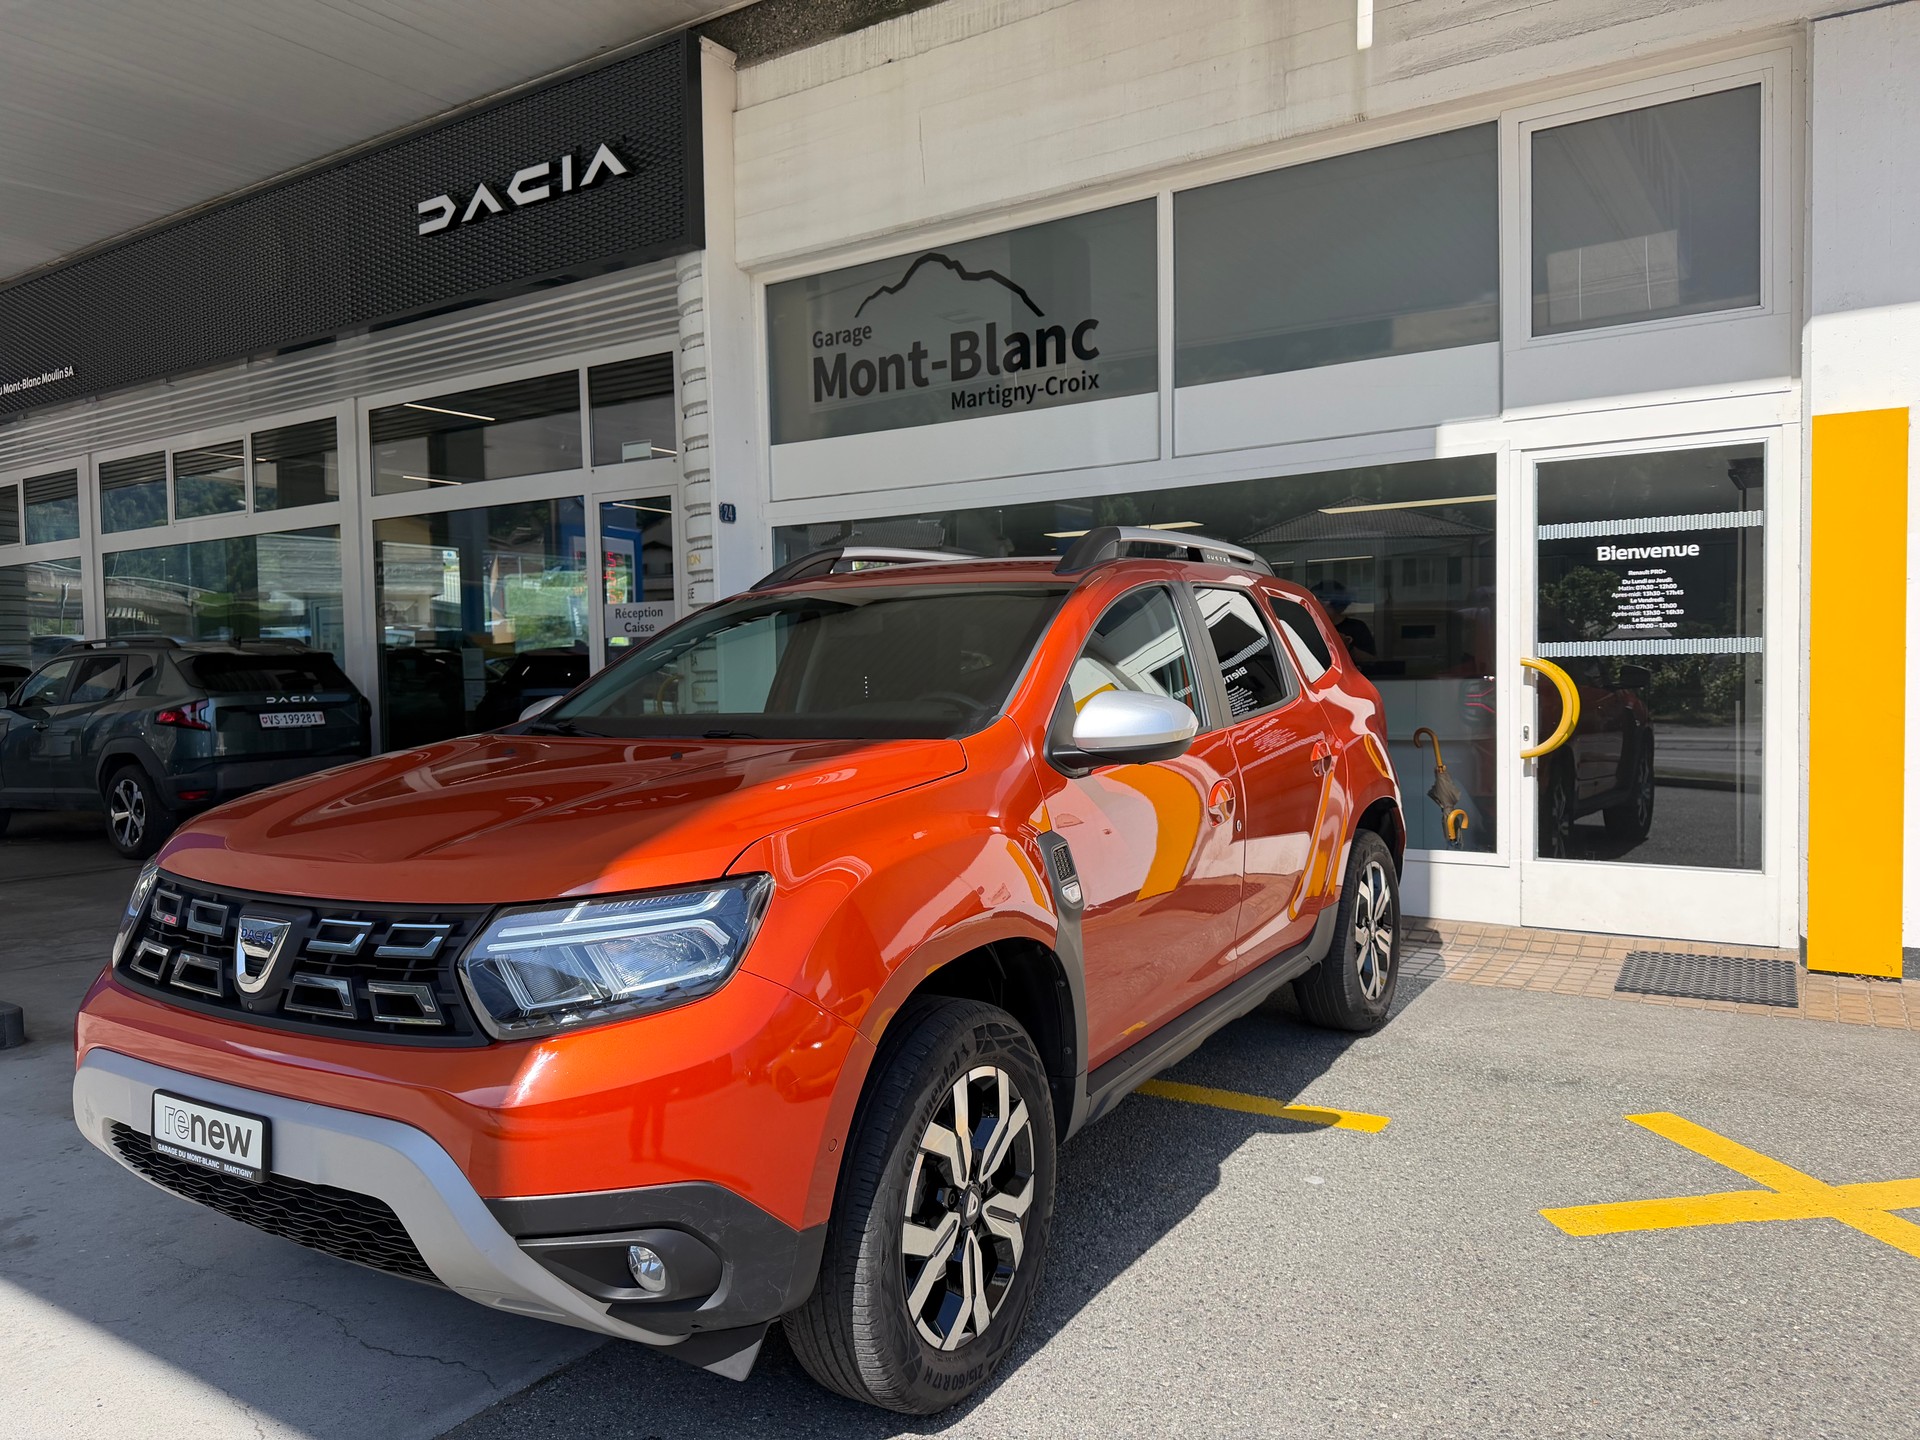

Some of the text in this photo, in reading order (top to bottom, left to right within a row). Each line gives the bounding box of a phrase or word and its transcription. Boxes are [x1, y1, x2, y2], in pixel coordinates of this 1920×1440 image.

[418, 142, 628, 235] DACIA
[812, 324, 872, 349] Garage
[812, 318, 1100, 402] Mont-Blanc
[3, 376, 41, 395] Mont-Blanc
[41, 368, 64, 385] Moulin
[64, 365, 74, 378] SA
[951, 370, 1100, 410] Martigny-Croix
[1596, 543, 1700, 561] Bienvenue
[615, 606, 663, 621] Réception
[624, 622, 655, 633] Caisse
[266, 695, 317, 704] DACIA
[241, 927, 274, 942] DACIA
[164, 1105, 253, 1158] renew
[157, 1143, 178, 1156] GARAGE
[186, 1152, 220, 1169] MONT-BLANC
[223, 1163, 253, 1178] MARTIGNY
